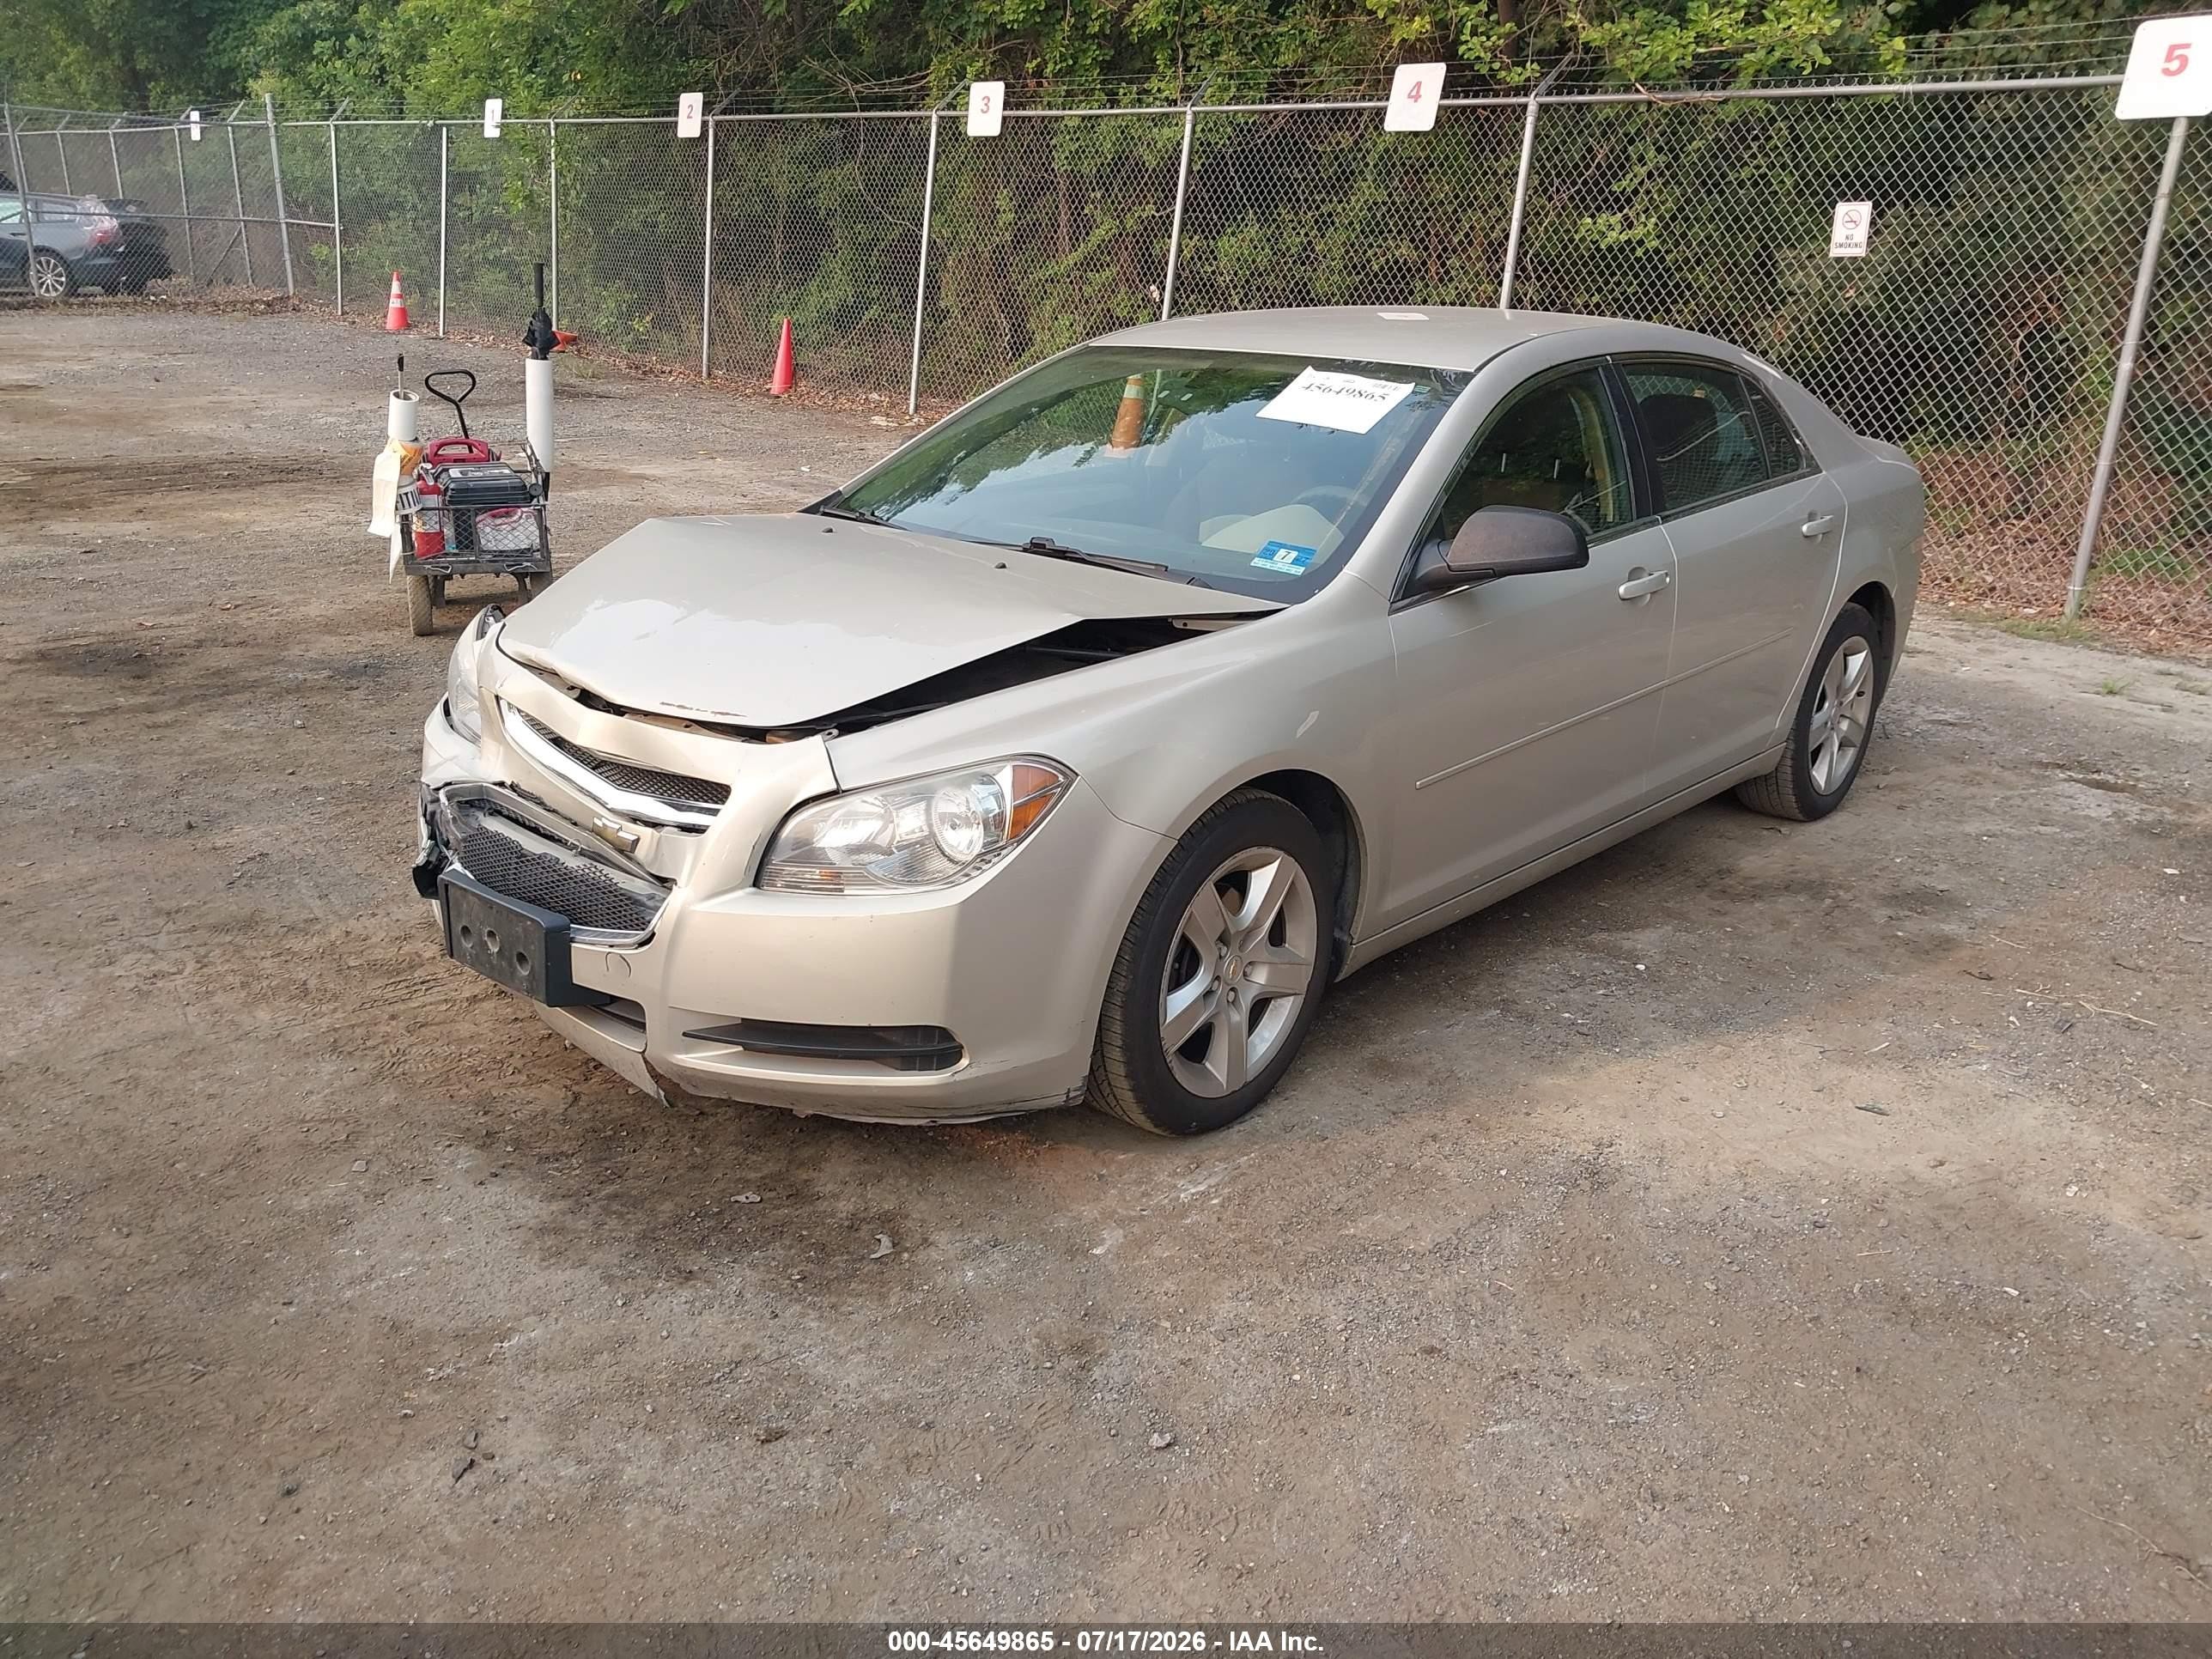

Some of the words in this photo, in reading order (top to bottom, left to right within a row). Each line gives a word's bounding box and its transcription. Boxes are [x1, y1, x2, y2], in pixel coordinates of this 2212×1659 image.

[2161, 43, 2192, 77] 5
[1407, 81, 1423, 103] 4
[686, 103, 694, 119] 2
[981, 95, 991, 114] 3
[1302, 383, 1389, 401] 45649865
[1280, 550, 1292, 561] 7
